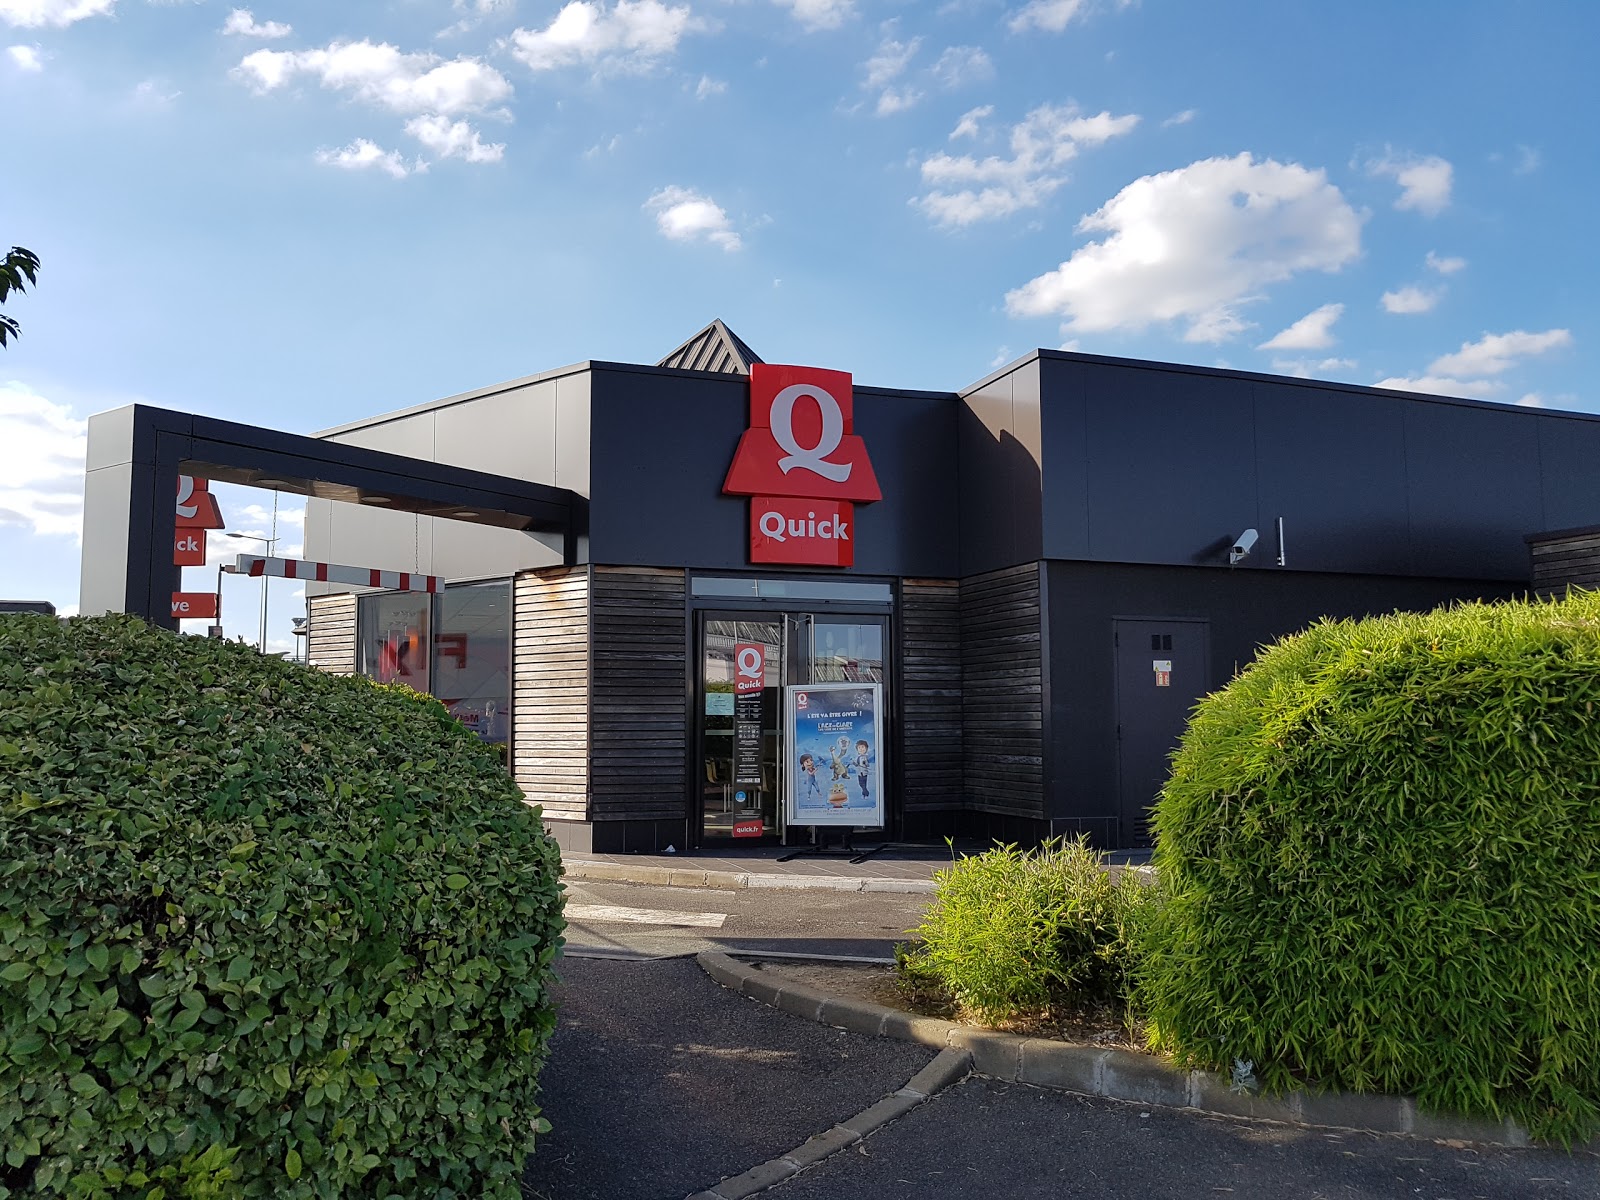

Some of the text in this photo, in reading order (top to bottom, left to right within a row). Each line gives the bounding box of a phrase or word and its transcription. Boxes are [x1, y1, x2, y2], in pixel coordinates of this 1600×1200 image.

[770, 384, 853, 483] Q
[759, 511, 849, 542] Quick
[737, 647, 762, 679] Q
[738, 680, 761, 690] Quick
